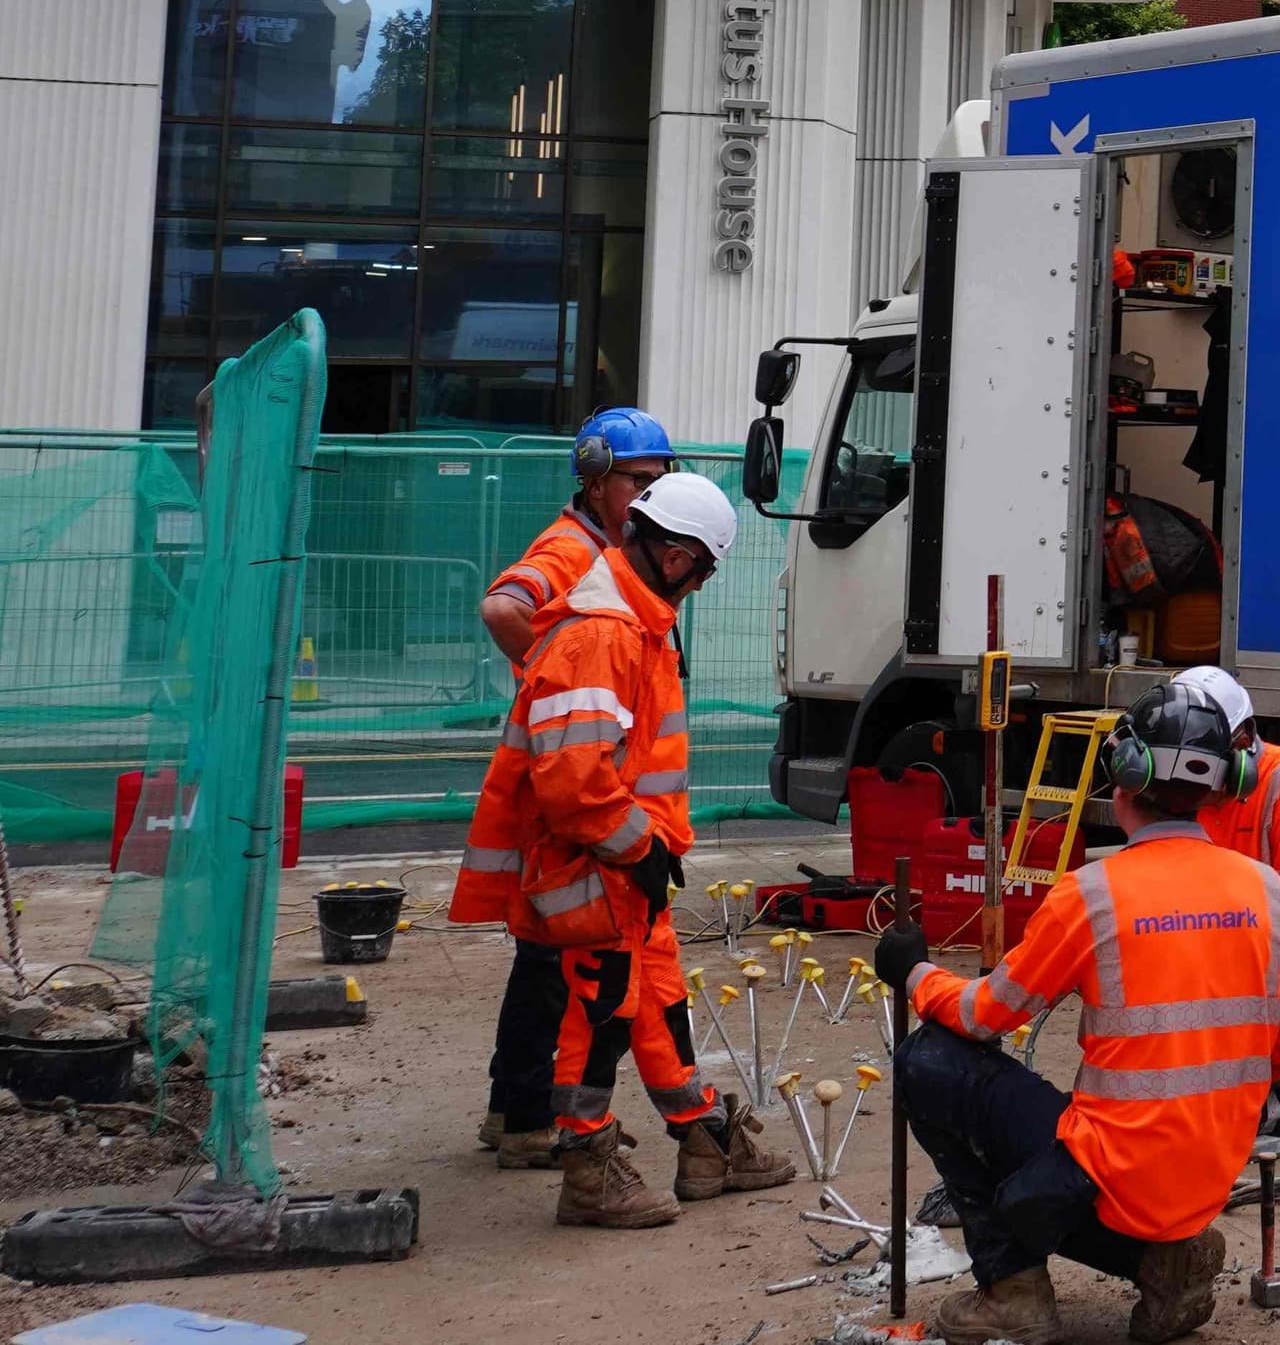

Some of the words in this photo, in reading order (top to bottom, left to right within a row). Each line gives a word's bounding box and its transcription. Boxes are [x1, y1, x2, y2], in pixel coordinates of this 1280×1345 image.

[714, 98, 771, 274] House
[808, 671, 835, 684] LF
[1134, 907, 1258, 935] mainmark
